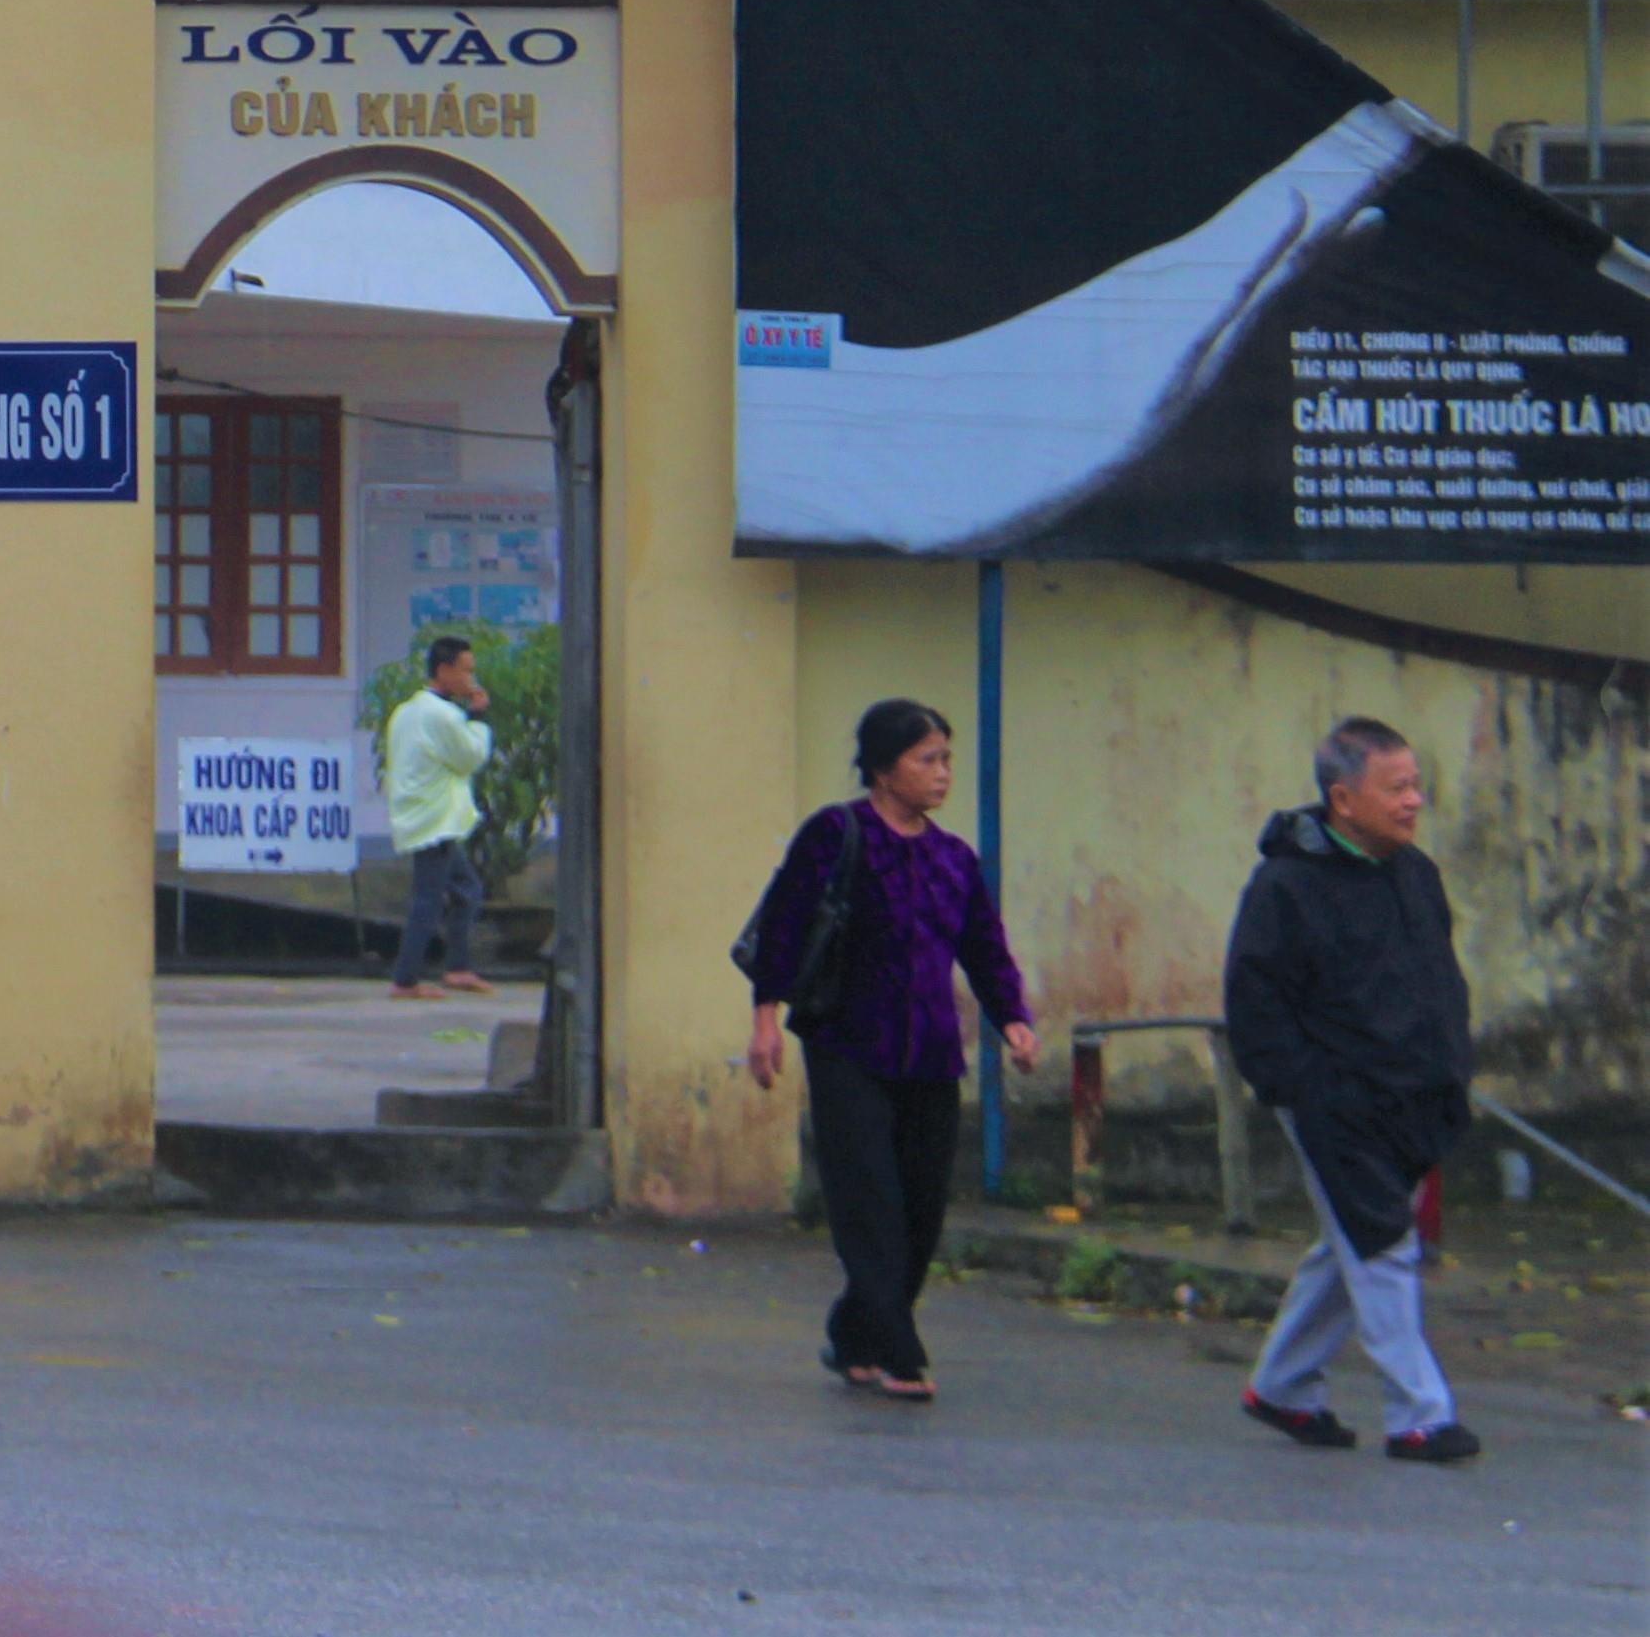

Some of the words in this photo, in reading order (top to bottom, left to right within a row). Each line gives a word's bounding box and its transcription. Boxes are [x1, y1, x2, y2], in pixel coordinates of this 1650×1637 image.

[181, 5, 355, 63] LỐI
[384, 12, 578, 65] VÀO
[230, 76, 337, 137] CỦA
[357, 82, 537, 137] KHÁCH
[40, 368, 86, 460] SỐ
[94, 395, 111, 460] 1
[1293, 386, 1369, 434] CẤM
[1375, 392, 1441, 434] HÚT
[1445, 388, 1555, 435] THUỐC
[1561, 394, 1605, 436] LÁ
[194, 745, 297, 790] HƯỚNG
[310, 757, 340, 791] ĐI
[185, 802, 244, 837] KHOA
[254, 792, 298, 838] CẤP
